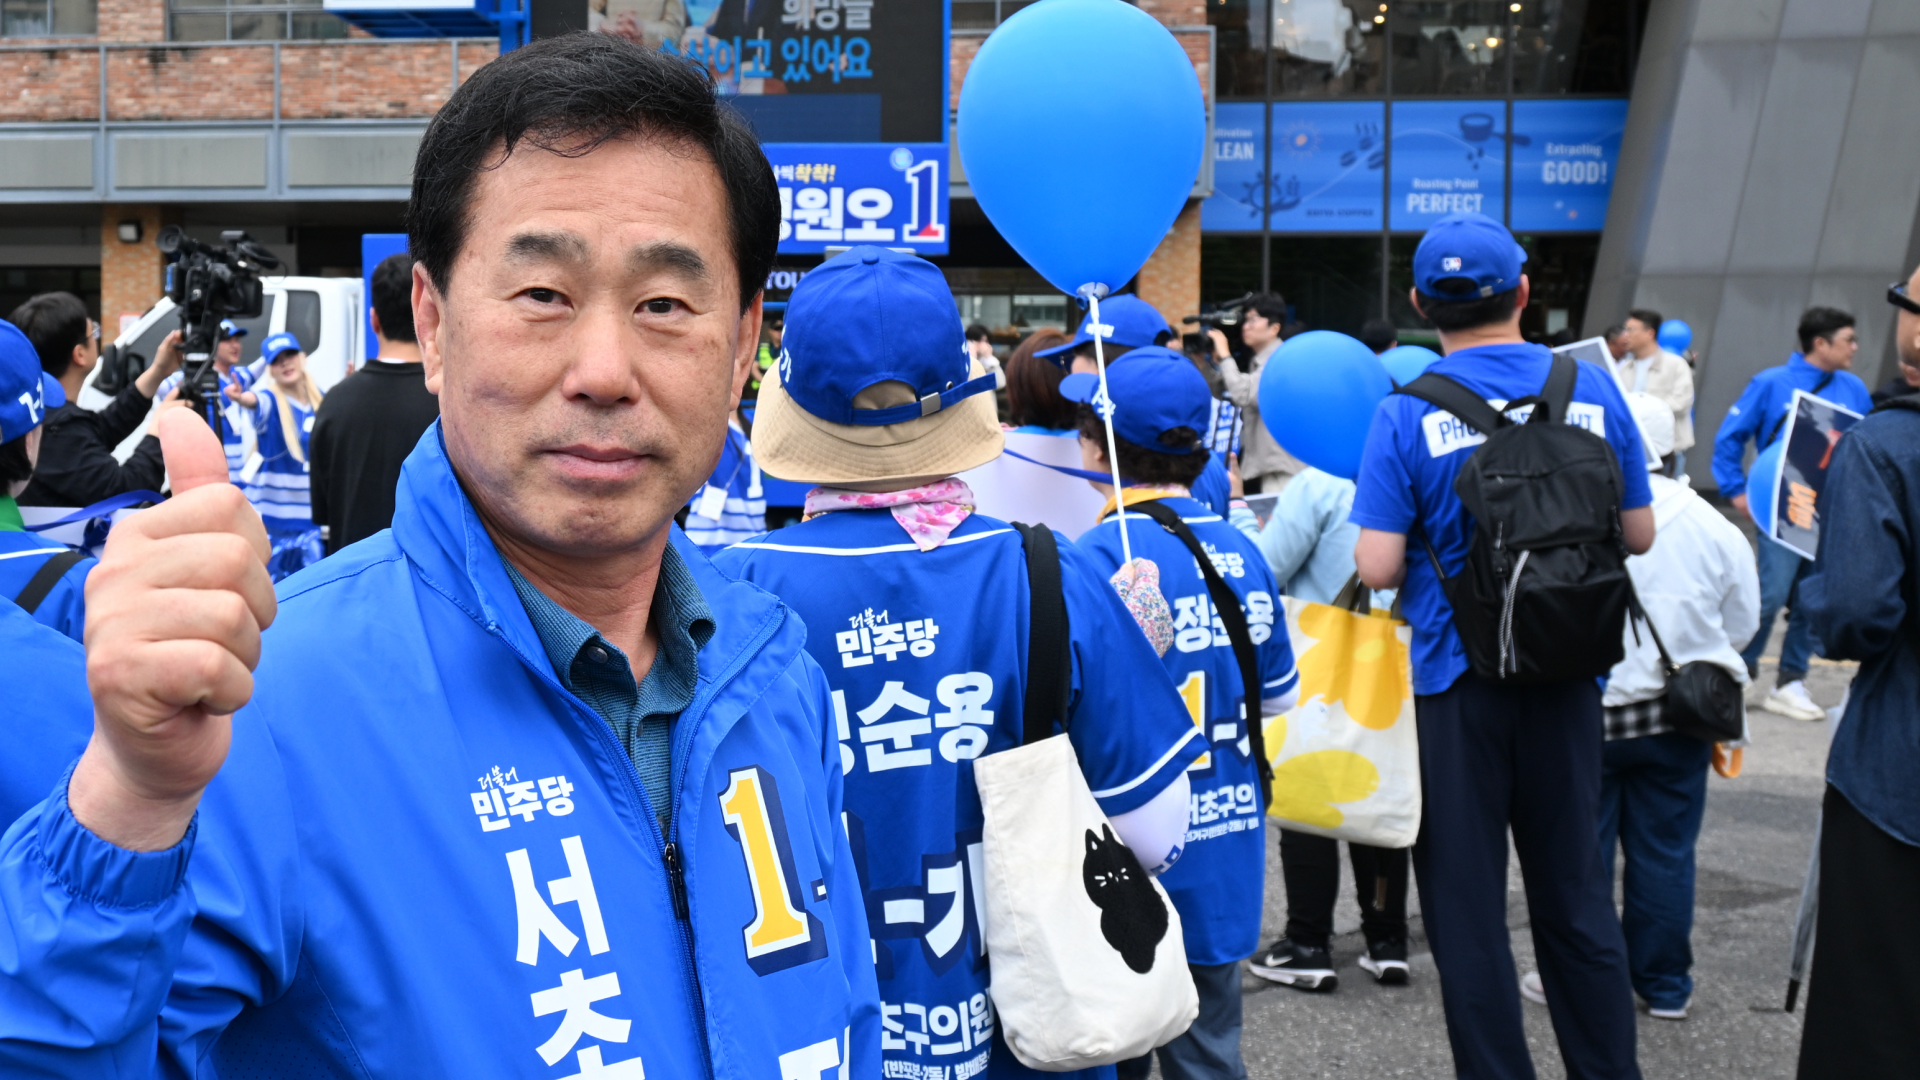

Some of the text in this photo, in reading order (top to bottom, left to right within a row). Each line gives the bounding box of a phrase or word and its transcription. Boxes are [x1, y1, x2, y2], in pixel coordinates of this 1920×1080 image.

[780, 35, 873, 84] 있어요
[1215, 142, 1255, 160] LEAN
[1542, 161, 1608, 184] GOOD!
[1407, 193, 1483, 213] PERFECT
[848, 607, 890, 630] 더불어
[836, 618, 939, 668] 민주당
[477, 765, 519, 790] 더불어
[470, 775, 575, 832] 민주당
